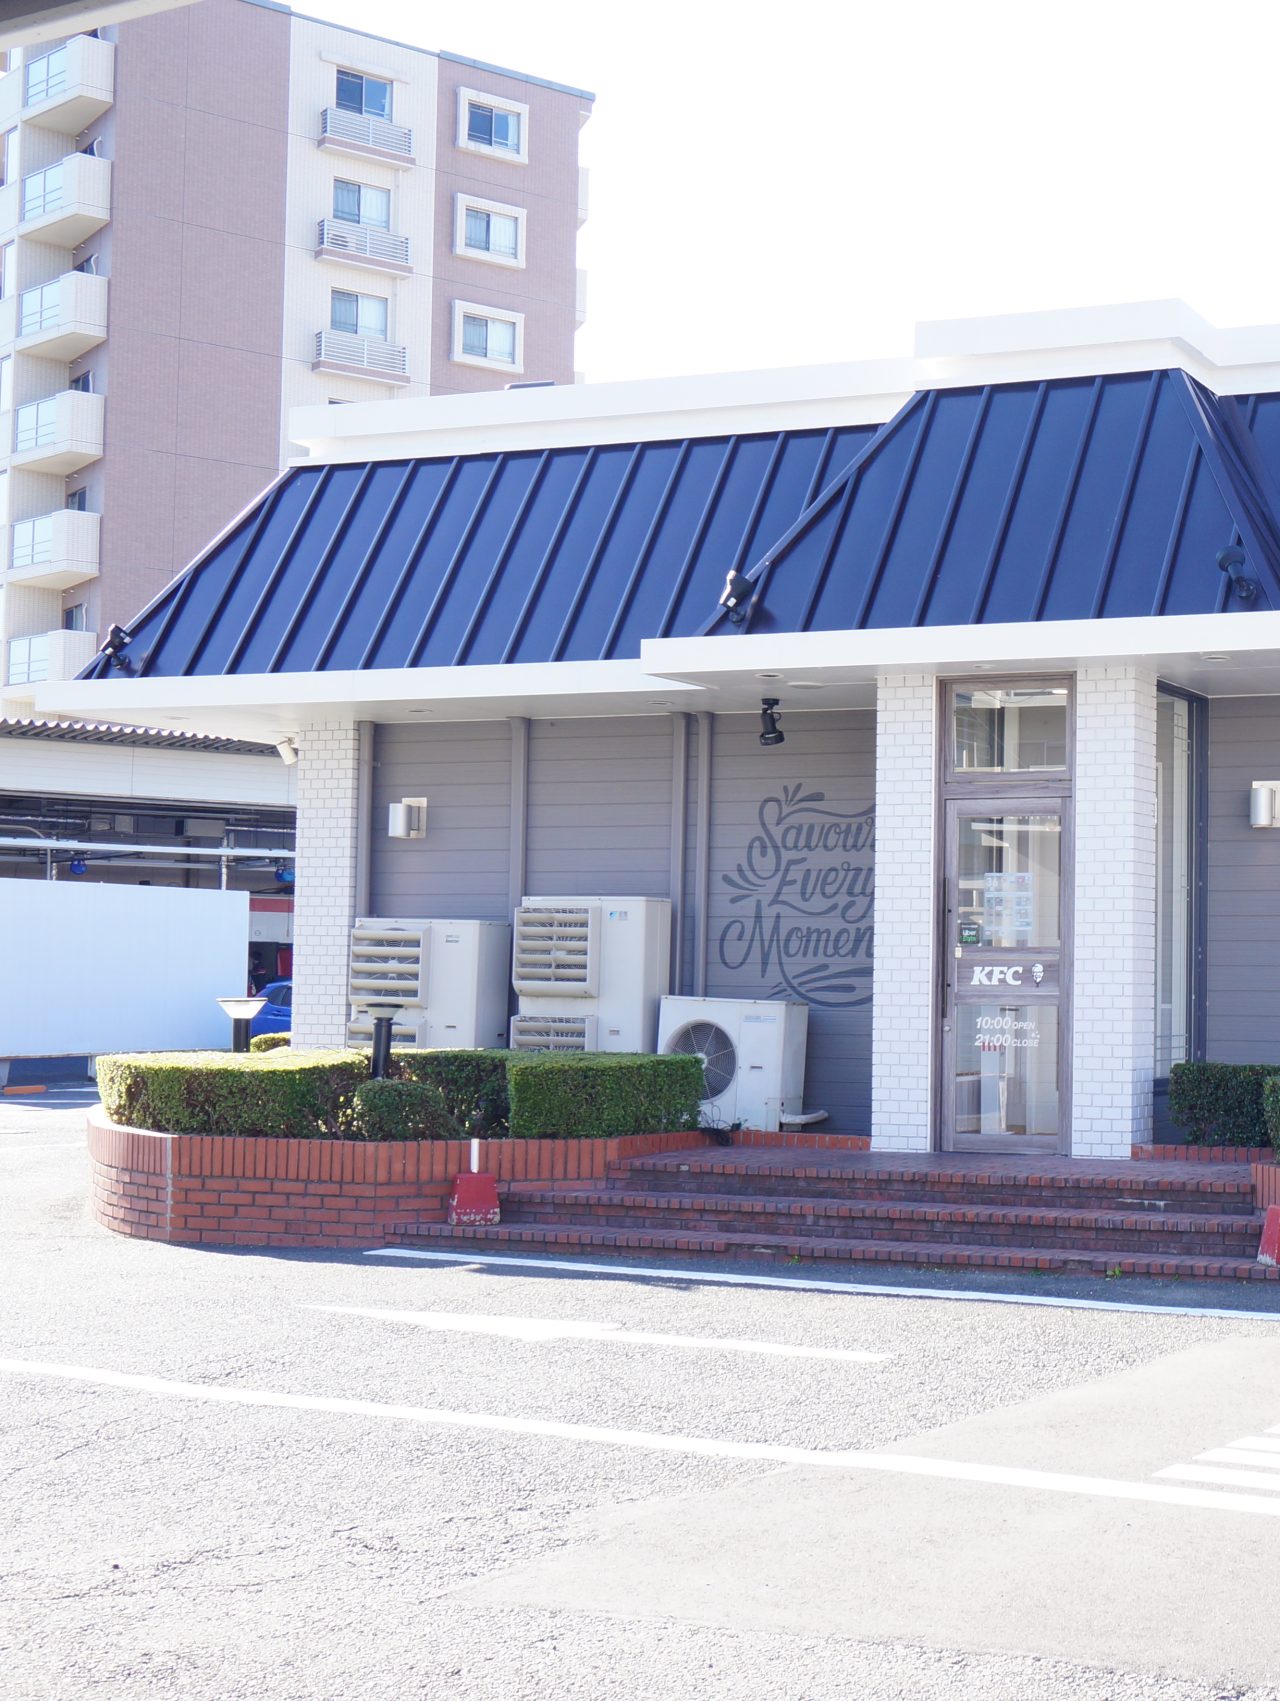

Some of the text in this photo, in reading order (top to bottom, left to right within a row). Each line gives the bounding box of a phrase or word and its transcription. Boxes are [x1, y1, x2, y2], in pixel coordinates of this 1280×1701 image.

[747, 797, 876, 881] Savou
[768, 857, 875, 924] Every
[719, 899, 875, 980] Momen
[970, 966, 1023, 985] KFC
[974, 1034, 1039, 1047] 21:00 CLOSE
[975, 1017, 1035, 1030] 10:00 OPEN
